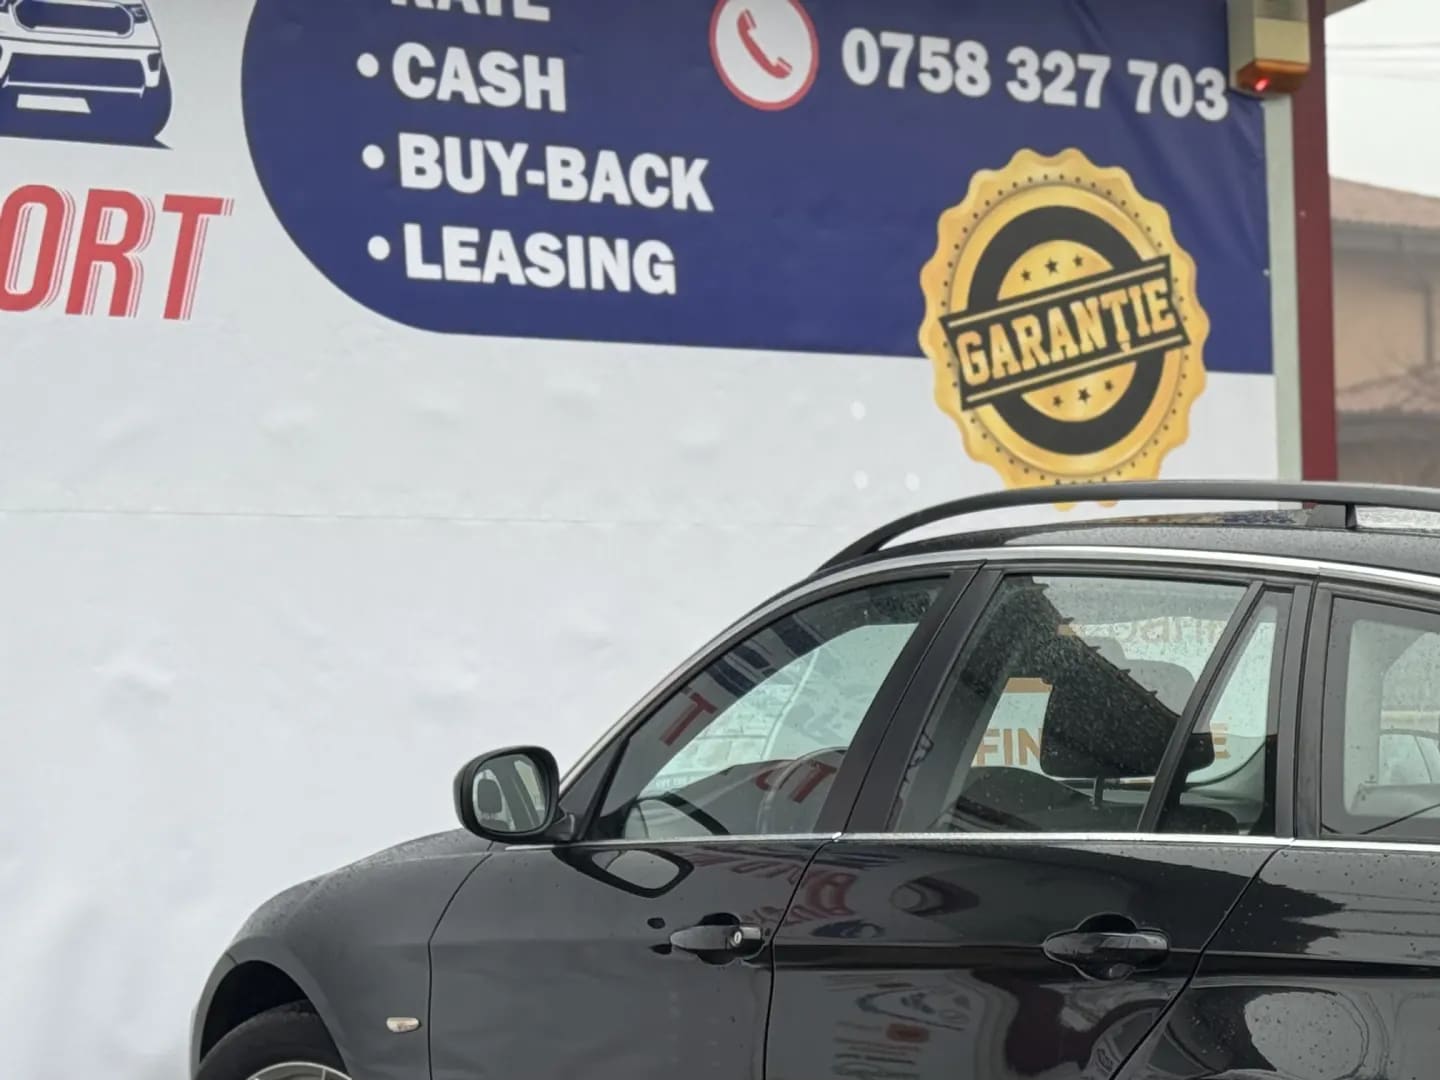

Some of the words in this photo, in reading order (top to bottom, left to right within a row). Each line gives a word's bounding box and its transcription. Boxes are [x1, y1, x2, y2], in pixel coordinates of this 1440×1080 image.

[392, 42, 567, 112] CASH
[841, 27, 991, 97] 0758
[1006, 46, 1110, 108] 327
[1127, 59, 1229, 121] 703
[399, 132, 714, 211] BUY-BACK
[404, 223, 677, 295] LEASING
